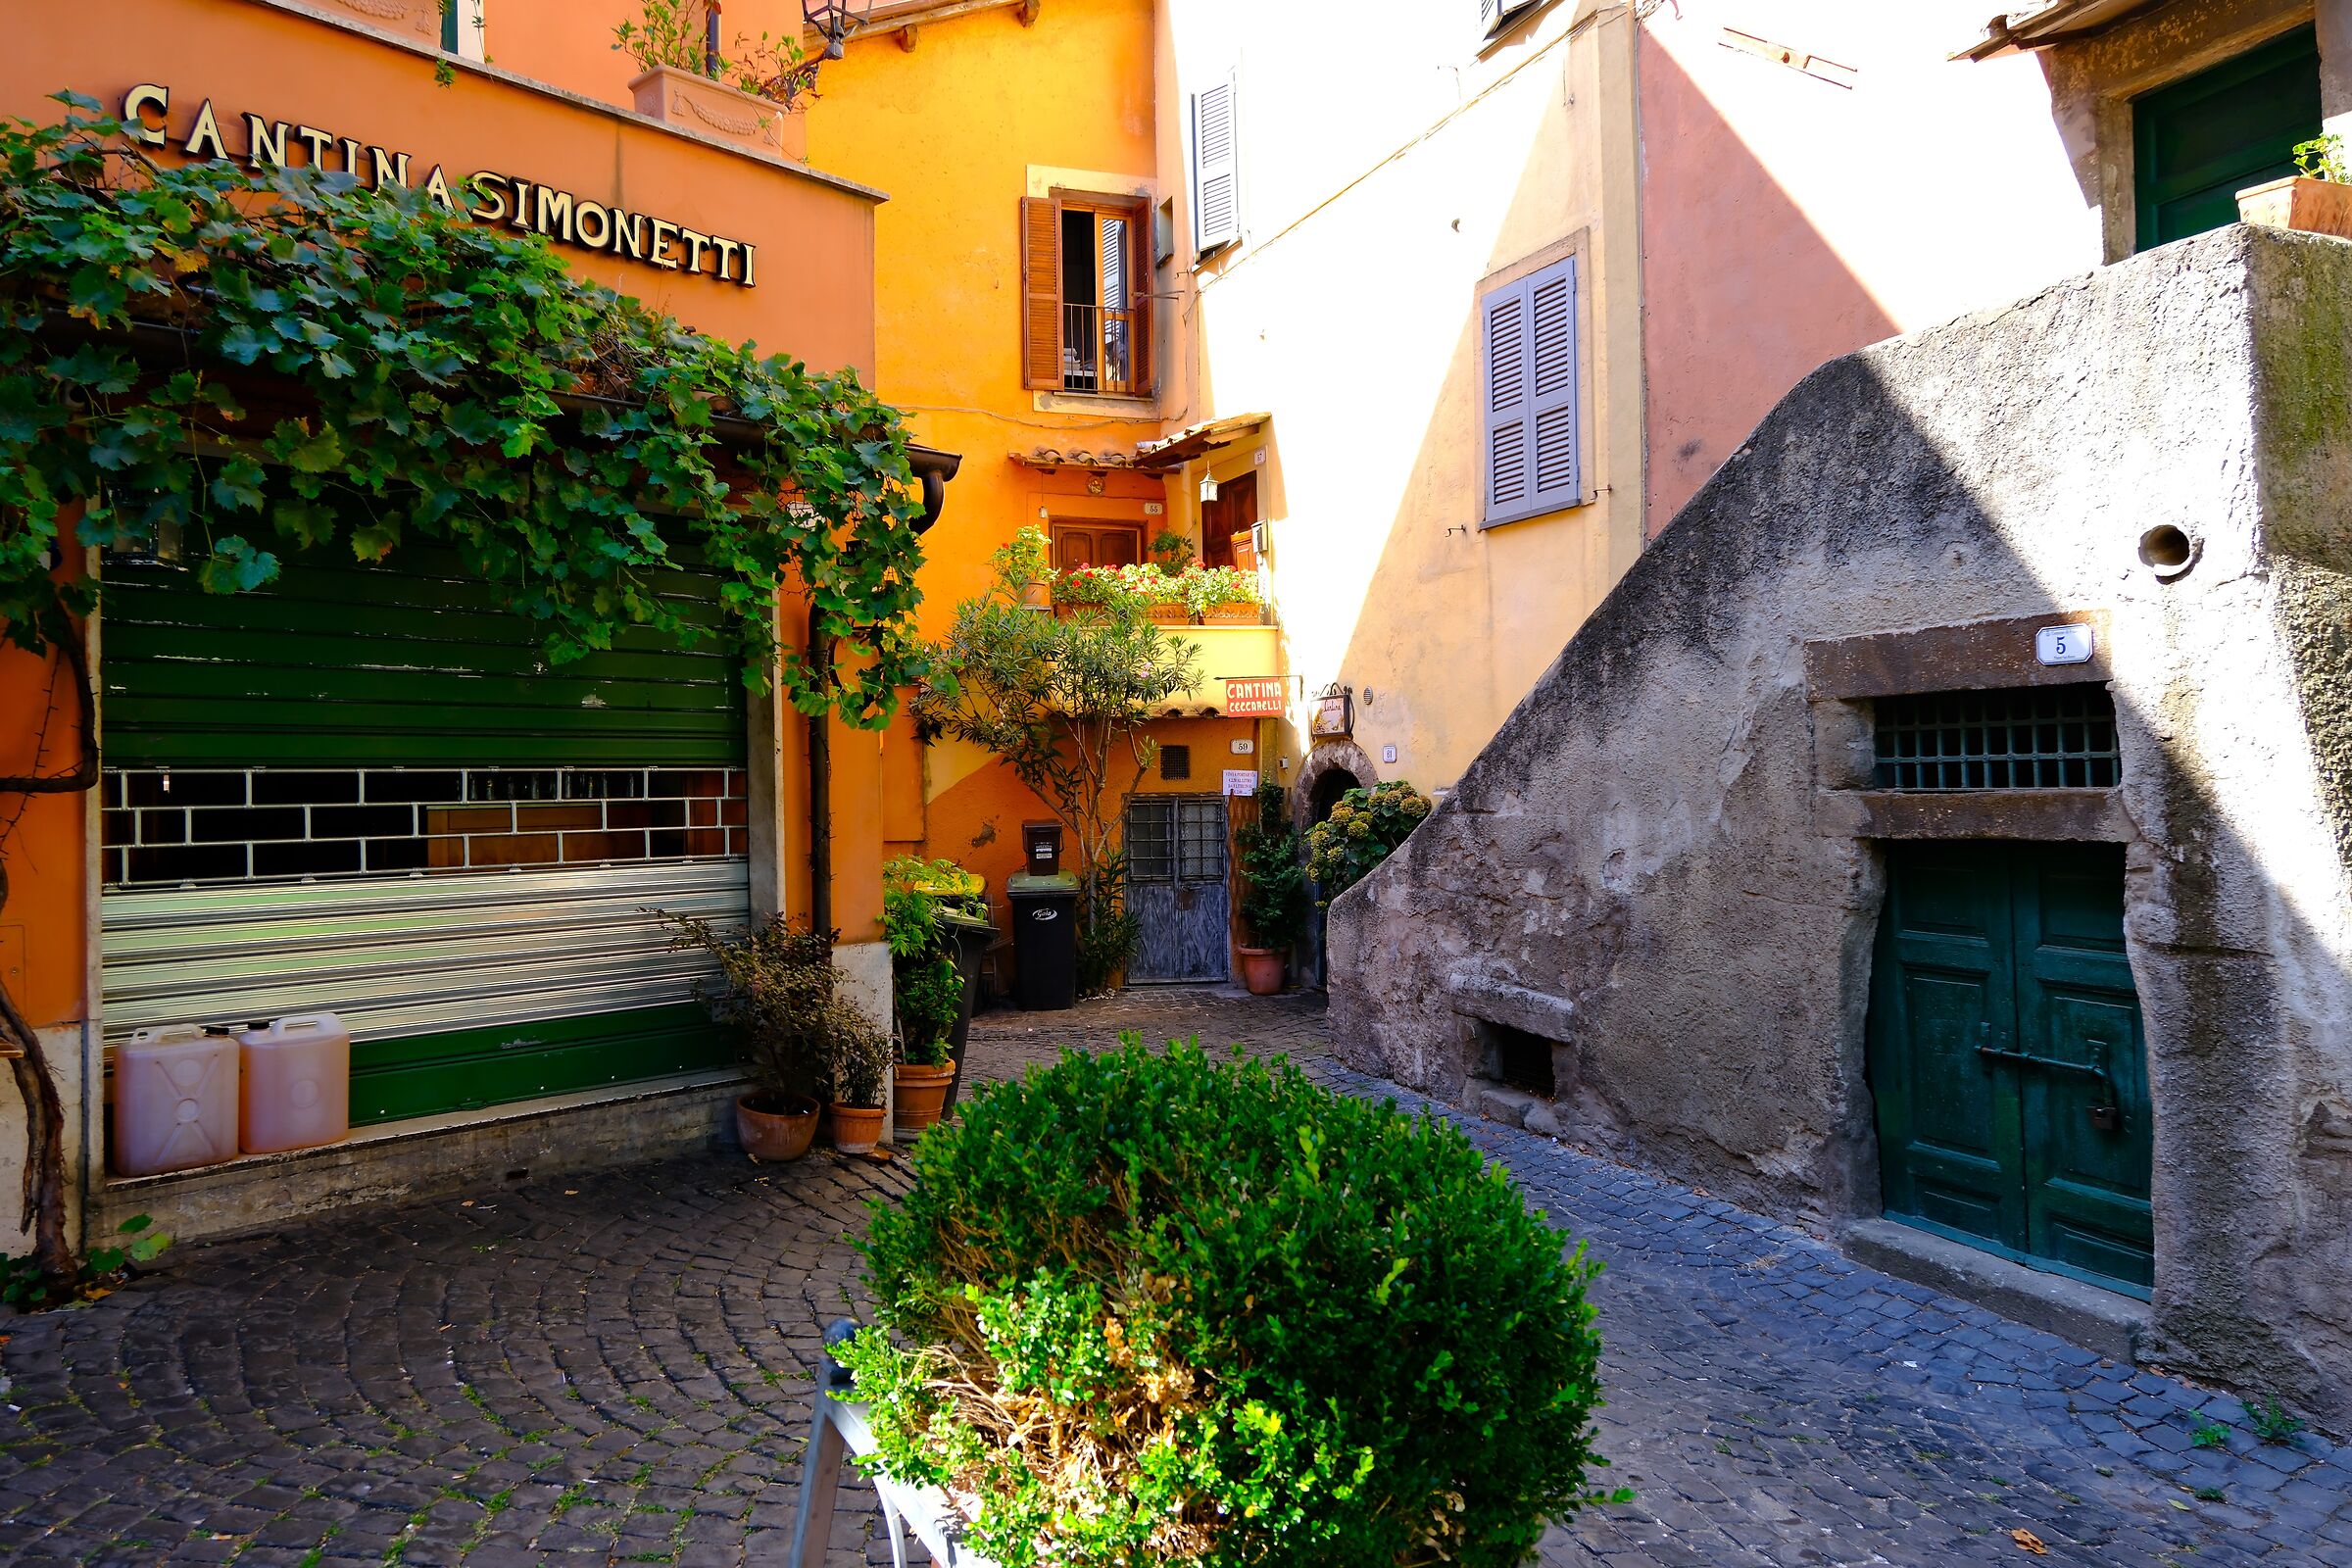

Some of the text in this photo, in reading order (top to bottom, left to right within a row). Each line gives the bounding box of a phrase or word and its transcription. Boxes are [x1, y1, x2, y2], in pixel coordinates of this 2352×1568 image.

[121, 83, 757, 288] CANTINA SIMONETTI
[2056, 636, 2066, 655] 5
[1227, 682, 1282, 699] CANTINA
[1229, 700, 1282, 712] CECCARELLI
